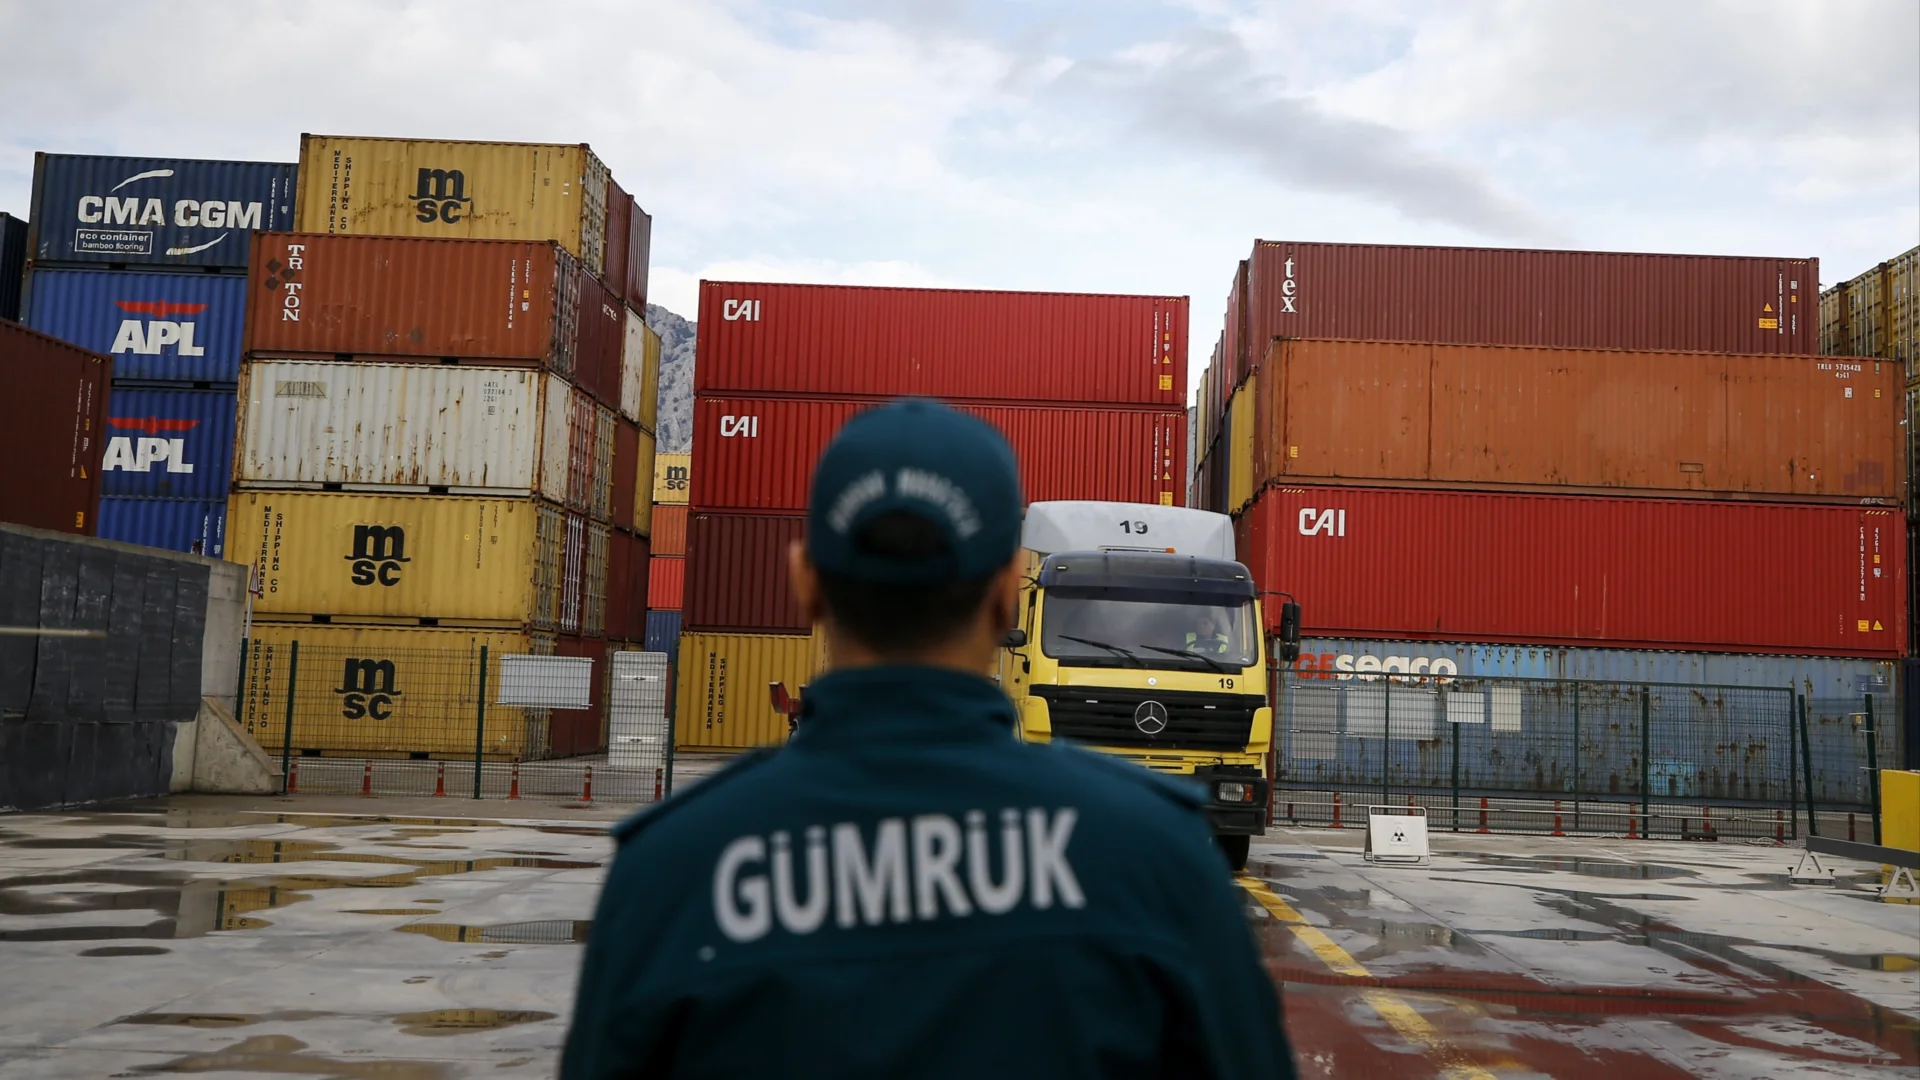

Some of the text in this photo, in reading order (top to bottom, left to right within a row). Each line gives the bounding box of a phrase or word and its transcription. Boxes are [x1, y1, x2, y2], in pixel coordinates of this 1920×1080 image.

[78, 195, 165, 226] CMA
[174, 199, 262, 229] CGM
[340, 157, 352, 230] SHIPPING CO
[82, 241, 144, 252] bamboo flooring
[100, 233, 149, 241] container
[1280, 257, 1297, 313] tex
[723, 299, 760, 322] CAI
[110, 319, 205, 356] APL
[720, 415, 758, 438] CAI
[102, 436, 194, 474] APL
[1119, 520, 1149, 535] 19
[1298, 508, 1346, 537] CAI
[257, 506, 272, 600] MEDITERRANEAN
[270, 513, 283, 594] SHIPPING CO
[247, 638, 262, 735] MEDITERRANEAN
[260, 646, 273, 728] SHIPPING CO
[706, 652, 717, 730] MEDITERRANEAN
[716, 658, 726, 724] SHIPPING CO
[1218, 678, 1234, 690] 19
[713, 807, 1087, 942] GÜMRÜK
